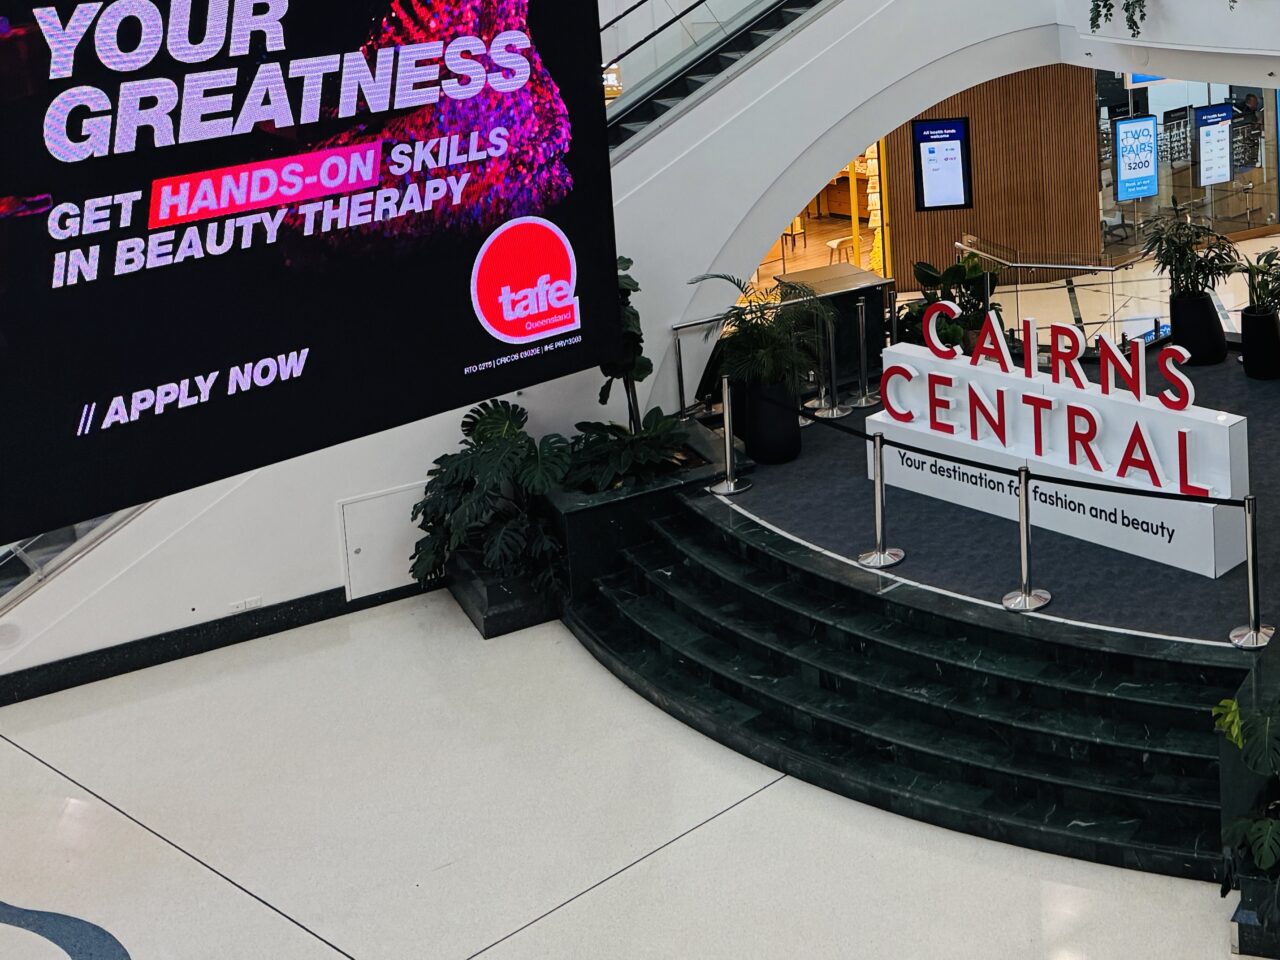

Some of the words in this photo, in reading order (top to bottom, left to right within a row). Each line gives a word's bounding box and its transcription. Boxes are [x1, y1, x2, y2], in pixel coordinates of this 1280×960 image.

[42, 30, 533, 163] GREATNESS
[47, 190, 143, 240] GET
[157, 149, 377, 221] HANDS-ON
[388, 126, 511, 176] SKILLS
[1121, 142, 1152, 155] PAIRS
[1127, 160, 1149, 171] $200
[52, 245, 101, 289] IN
[114, 209, 289, 276] BEAUTY
[299, 173, 472, 237] THERAPY
[498, 274, 574, 322] tafe
[525, 310, 572, 330] Queensland
[101, 372, 220, 429] APPLY
[227, 349, 309, 396] NOW
[923, 300, 1194, 411] CAIRNS
[880, 363, 1211, 497] CENTRAL
[897, 450, 928, 472] Your
[929, 462, 1005, 494] destination
[1032, 486, 1086, 515] fashion
[1089, 506, 1118, 525] and
[1121, 510, 1176, 544] beauty
